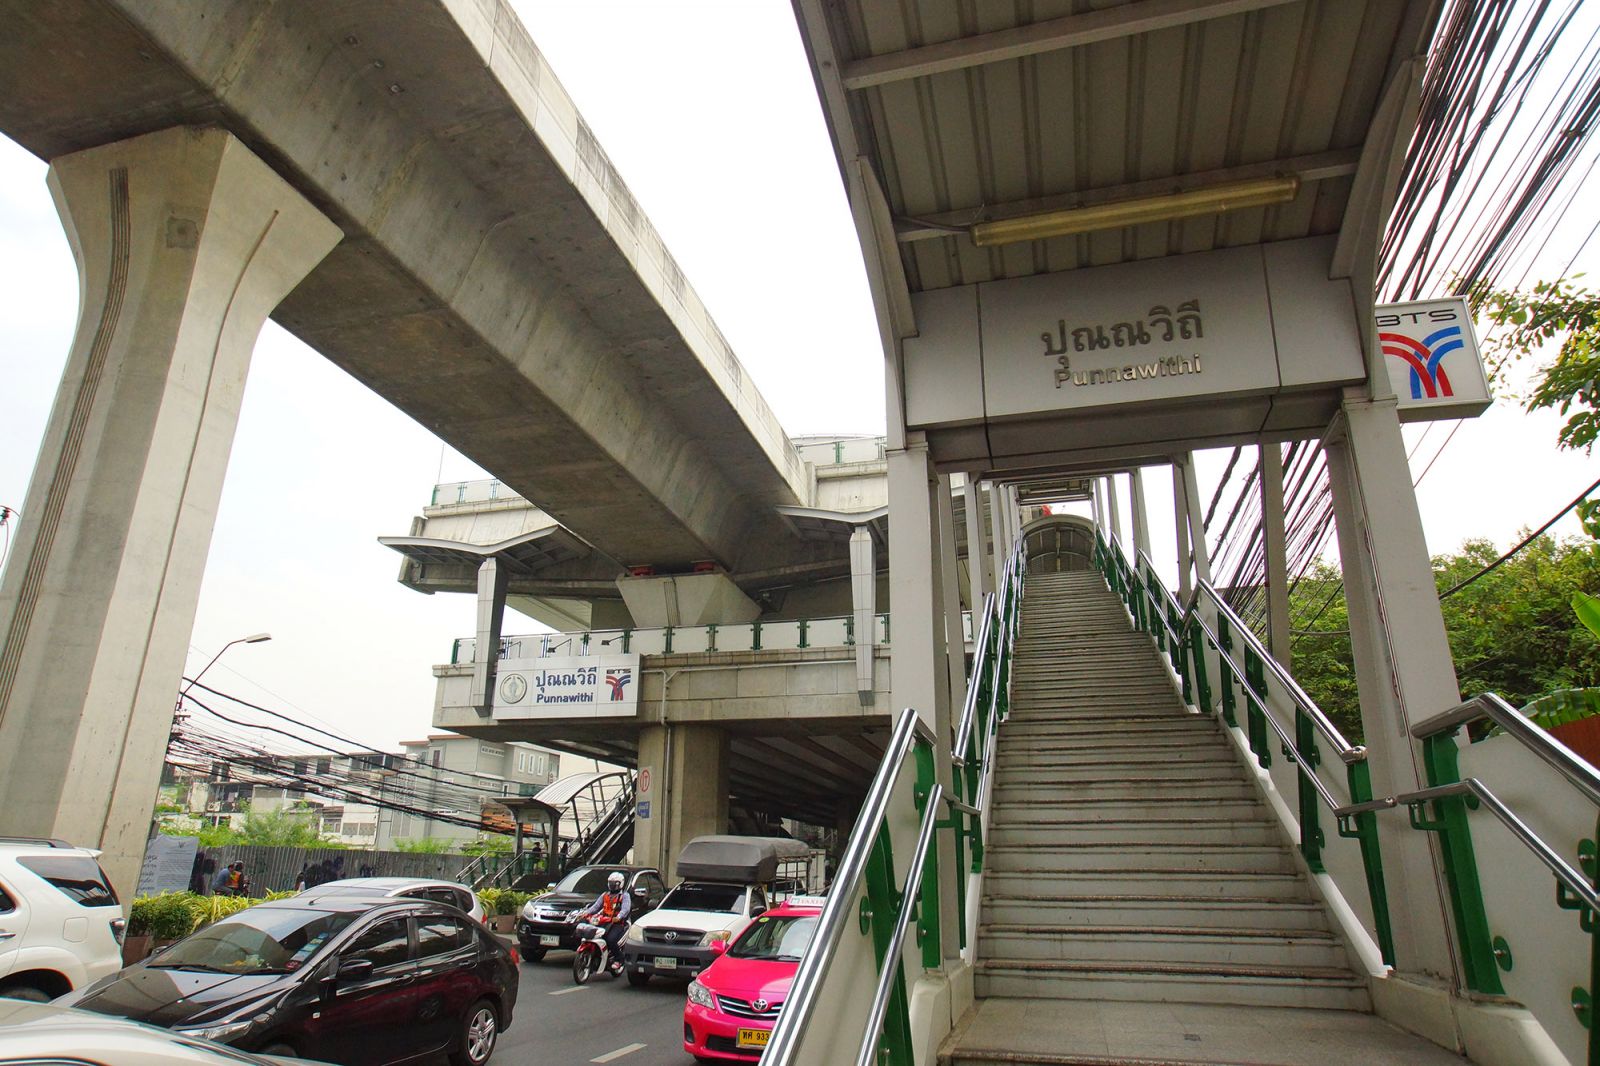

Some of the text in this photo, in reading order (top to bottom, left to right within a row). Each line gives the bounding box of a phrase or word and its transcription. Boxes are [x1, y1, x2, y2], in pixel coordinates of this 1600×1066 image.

[1375, 308, 1458, 328] BTS
[1040, 298, 1204, 370] ปุณณวิถี
[1053, 352, 1203, 389] Punnawithi
[535, 666, 598, 693] ปุณณวิถี
[536, 692, 594, 704] Punnawithi
